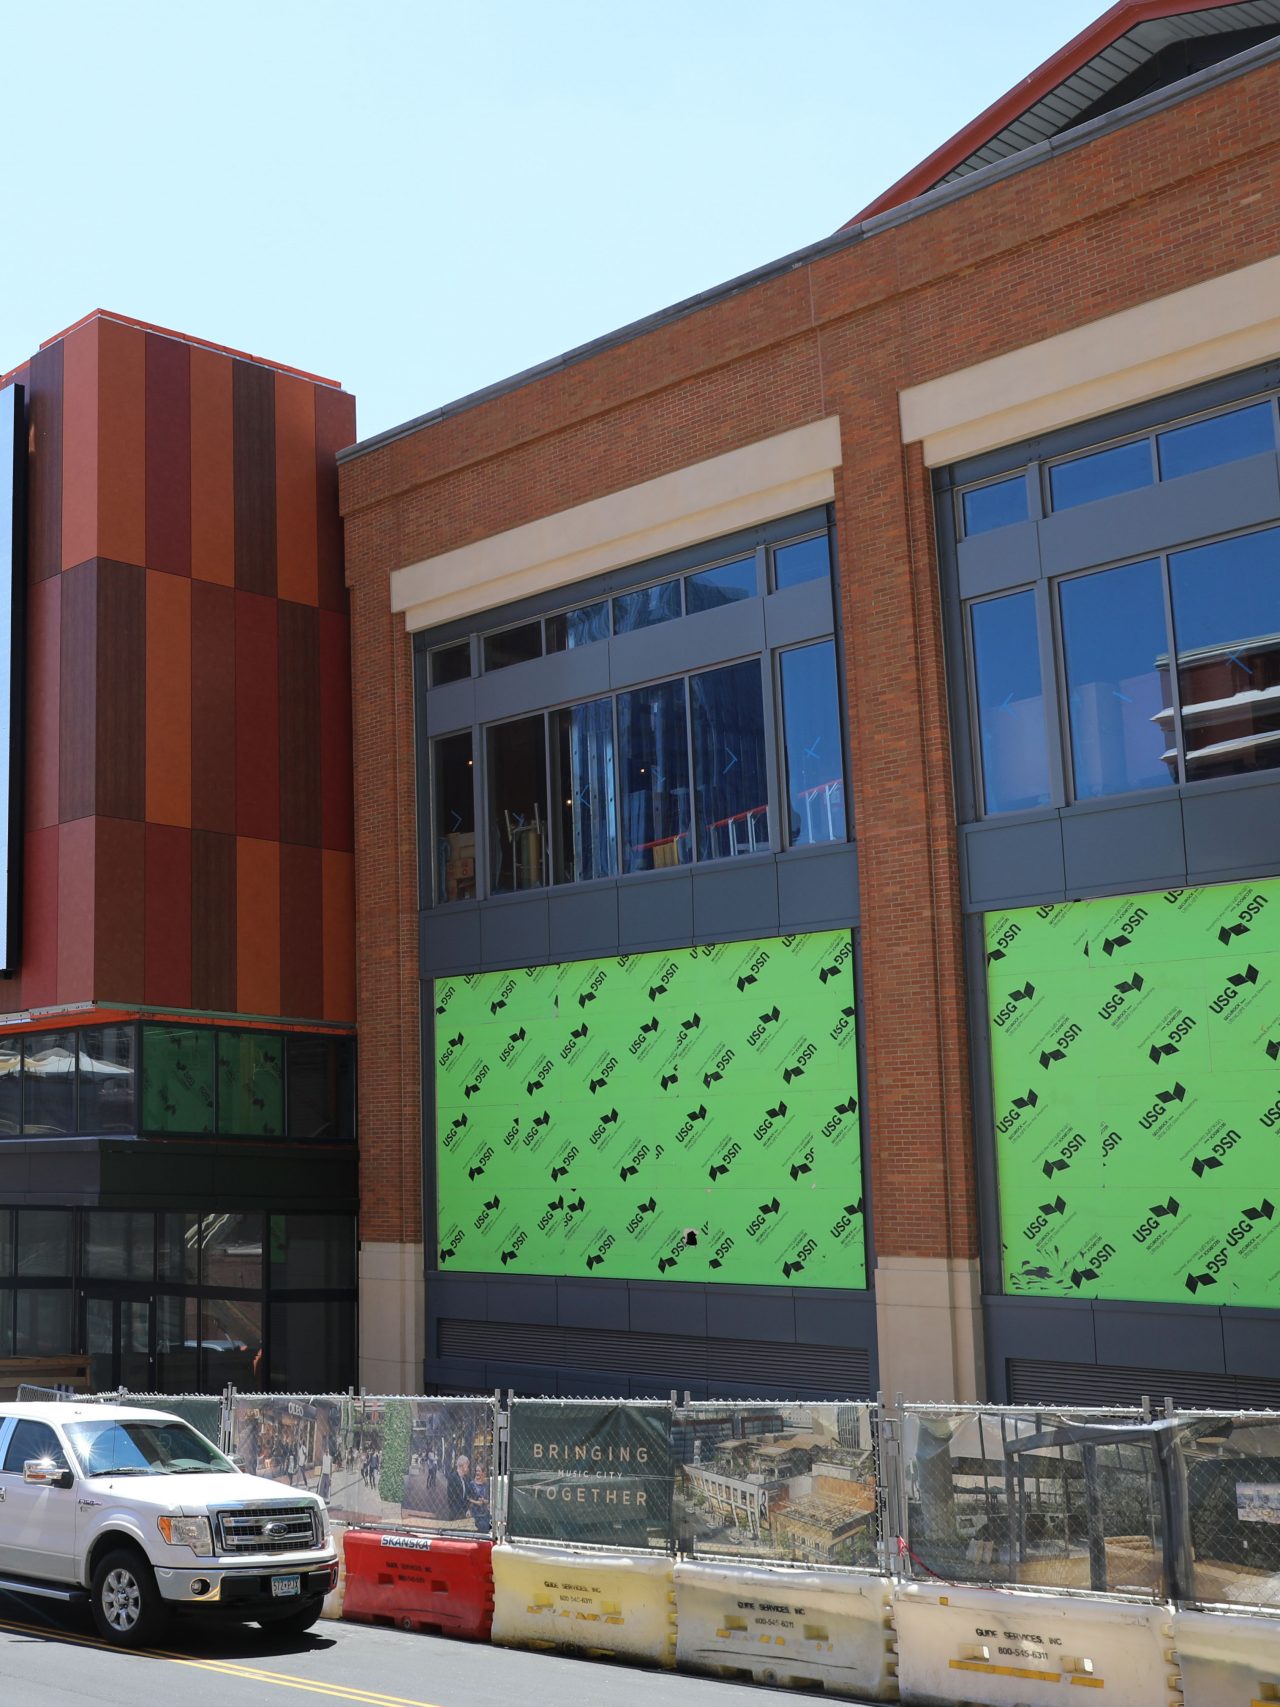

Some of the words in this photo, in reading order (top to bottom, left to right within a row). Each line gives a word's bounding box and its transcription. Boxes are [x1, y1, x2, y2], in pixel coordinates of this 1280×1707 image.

[1238, 895, 1268, 922] USG
[1121, 908, 1148, 934] USG
[997, 924, 1021, 948] USG
[617, 954, 630, 968] US
[702, 944, 715, 957] US
[750, 951, 770, 974] USG
[590, 971, 607, 992] USG
[660, 963, 679, 985] USG
[441, 987, 456, 1006] USG
[502, 980, 517, 1000] USG
[1209, 987, 1238, 1014] USG
[993, 1002, 1017, 1027] USG
[1098, 994, 1125, 1020] USG
[676, 1030, 688, 1047] SG
[746, 1024, 766, 1046] USG
[1057, 1023, 1082, 1049] USG
[1168, 1017, 1196, 1043] USG
[499, 1043, 515, 1063] USG
[559, 1039, 577, 1060] USG
[628, 1033, 647, 1055] USG
[796, 1043, 817, 1066] USG
[438, 1048, 454, 1067] USG
[600, 1057, 618, 1078] USG
[716, 1049, 735, 1071] USG
[475, 1064, 490, 1084] USG
[537, 1060, 554, 1081] USG
[821, 1114, 842, 1138] USG
[996, 1109, 1021, 1134] USG
[1139, 1103, 1166, 1130] USG
[443, 1128, 458, 1147] USG
[523, 1127, 539, 1146] USG
[589, 1124, 607, 1145] USG
[675, 1121, 694, 1143] USG
[753, 1118, 773, 1141] USG
[722, 1142, 741, 1164] USG
[1060, 1133, 1086, 1159] USG
[1212, 1130, 1241, 1157] USG
[479, 1147, 495, 1166] USG
[563, 1146, 579, 1166] USG
[632, 1144, 651, 1166] USG
[474, 1210, 490, 1230] USG
[537, 1210, 554, 1231] USG
[564, 1212, 574, 1228] SG
[626, 1213, 644, 1234] USG
[746, 1214, 766, 1237] USG
[830, 1215, 851, 1238] USG
[1023, 1215, 1048, 1240] USG
[1132, 1217, 1160, 1243] USG
[450, 1230, 465, 1250] USG
[511, 1231, 528, 1252] USG
[1226, 1220, 1253, 1247] USG
[598, 1234, 616, 1256] USG
[715, 1237, 735, 1259] USG
[797, 1239, 818, 1262] USG
[1089, 1243, 1116, 1269] USG
[533, 1443, 648, 1463] BRINGING
[558, 1469, 589, 1478] MUSIC
[595, 1470, 623, 1479] CITY
[532, 1486, 647, 1506] TOGETHER
[382, 1537, 429, 1550] SKANSKA
